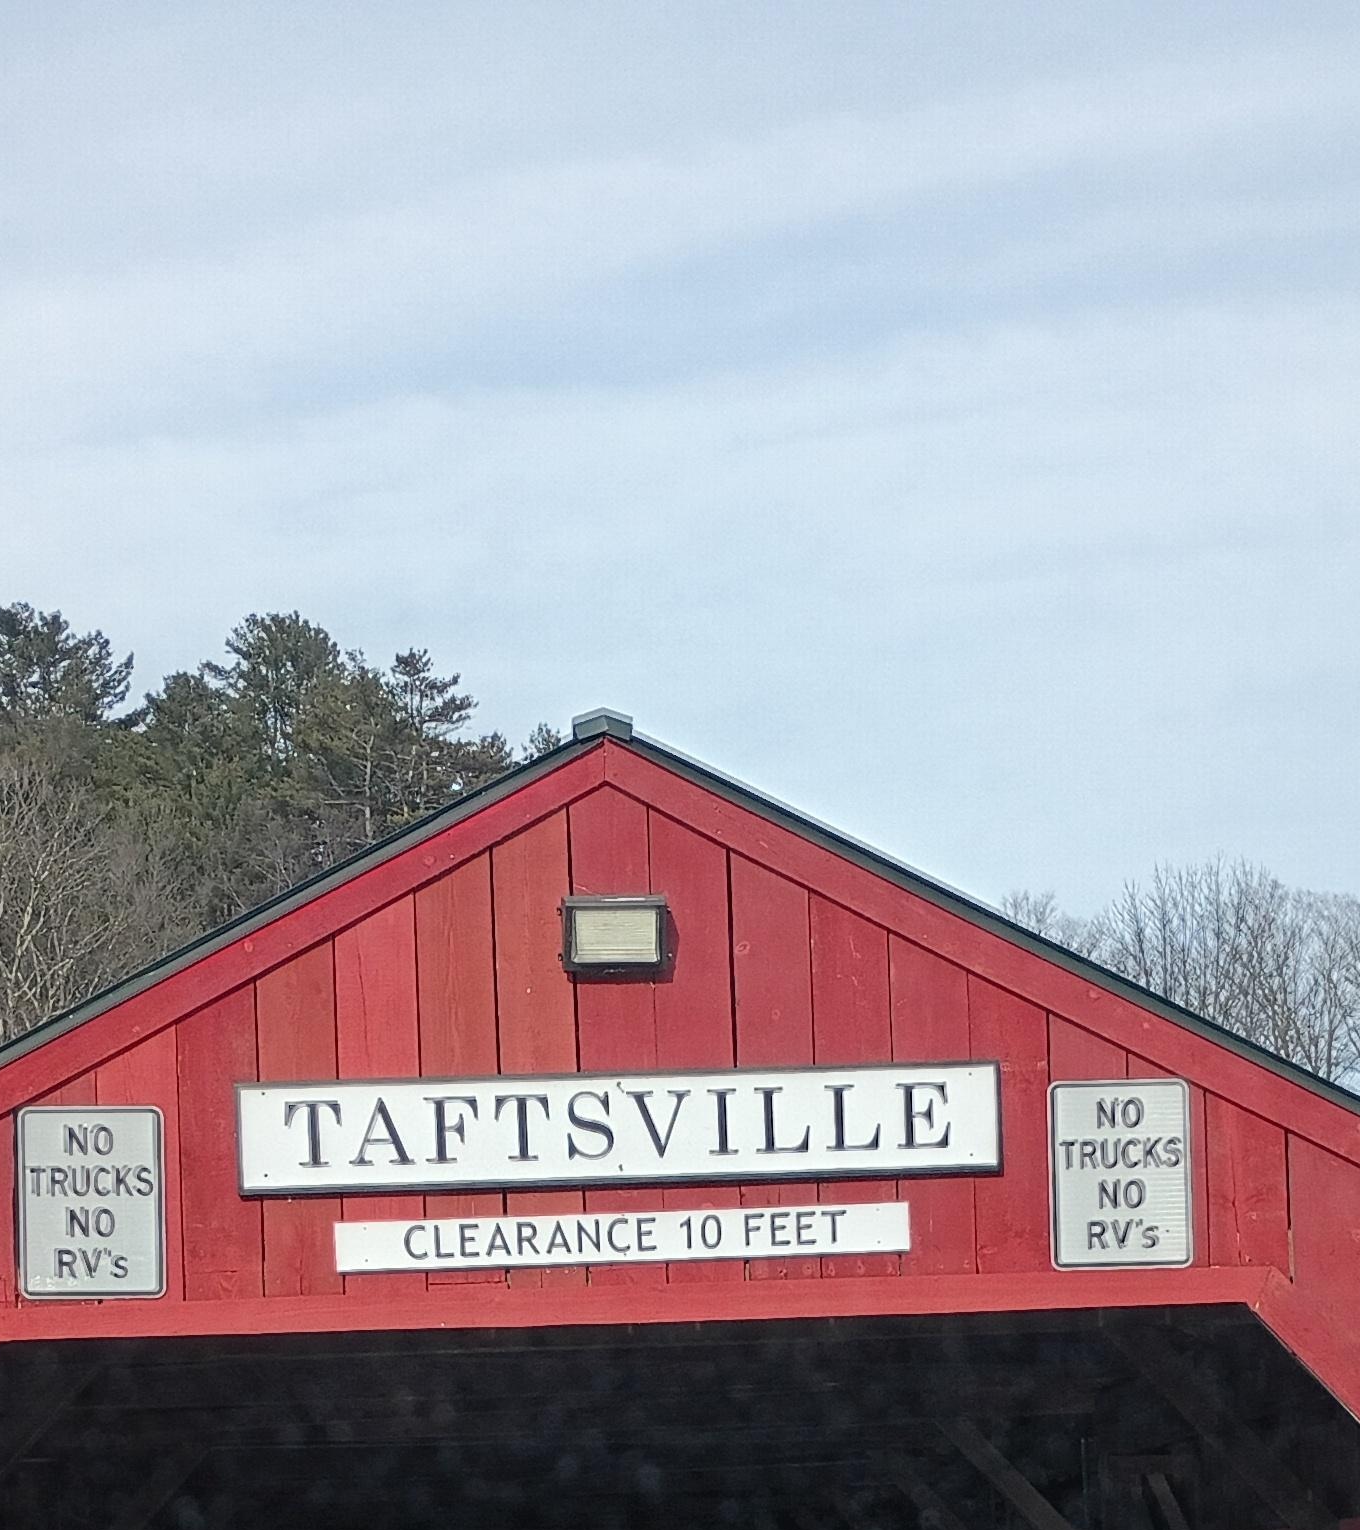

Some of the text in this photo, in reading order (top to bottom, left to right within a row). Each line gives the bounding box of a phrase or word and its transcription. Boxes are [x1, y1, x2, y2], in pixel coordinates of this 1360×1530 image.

[284, 1081, 953, 1170] TAFTSVILLE
[1096, 1097, 1144, 1129] NO
[65, 1124, 114, 1156] NO
[1059, 1136, 1183, 1170] TRUCKS
[26, 1165, 154, 1197] TRUCKS
[1098, 1178, 1146, 1209] NO
[67, 1207, 115, 1238] NO
[403, 1209, 848, 1260] CLEARANCE 10 FEET
